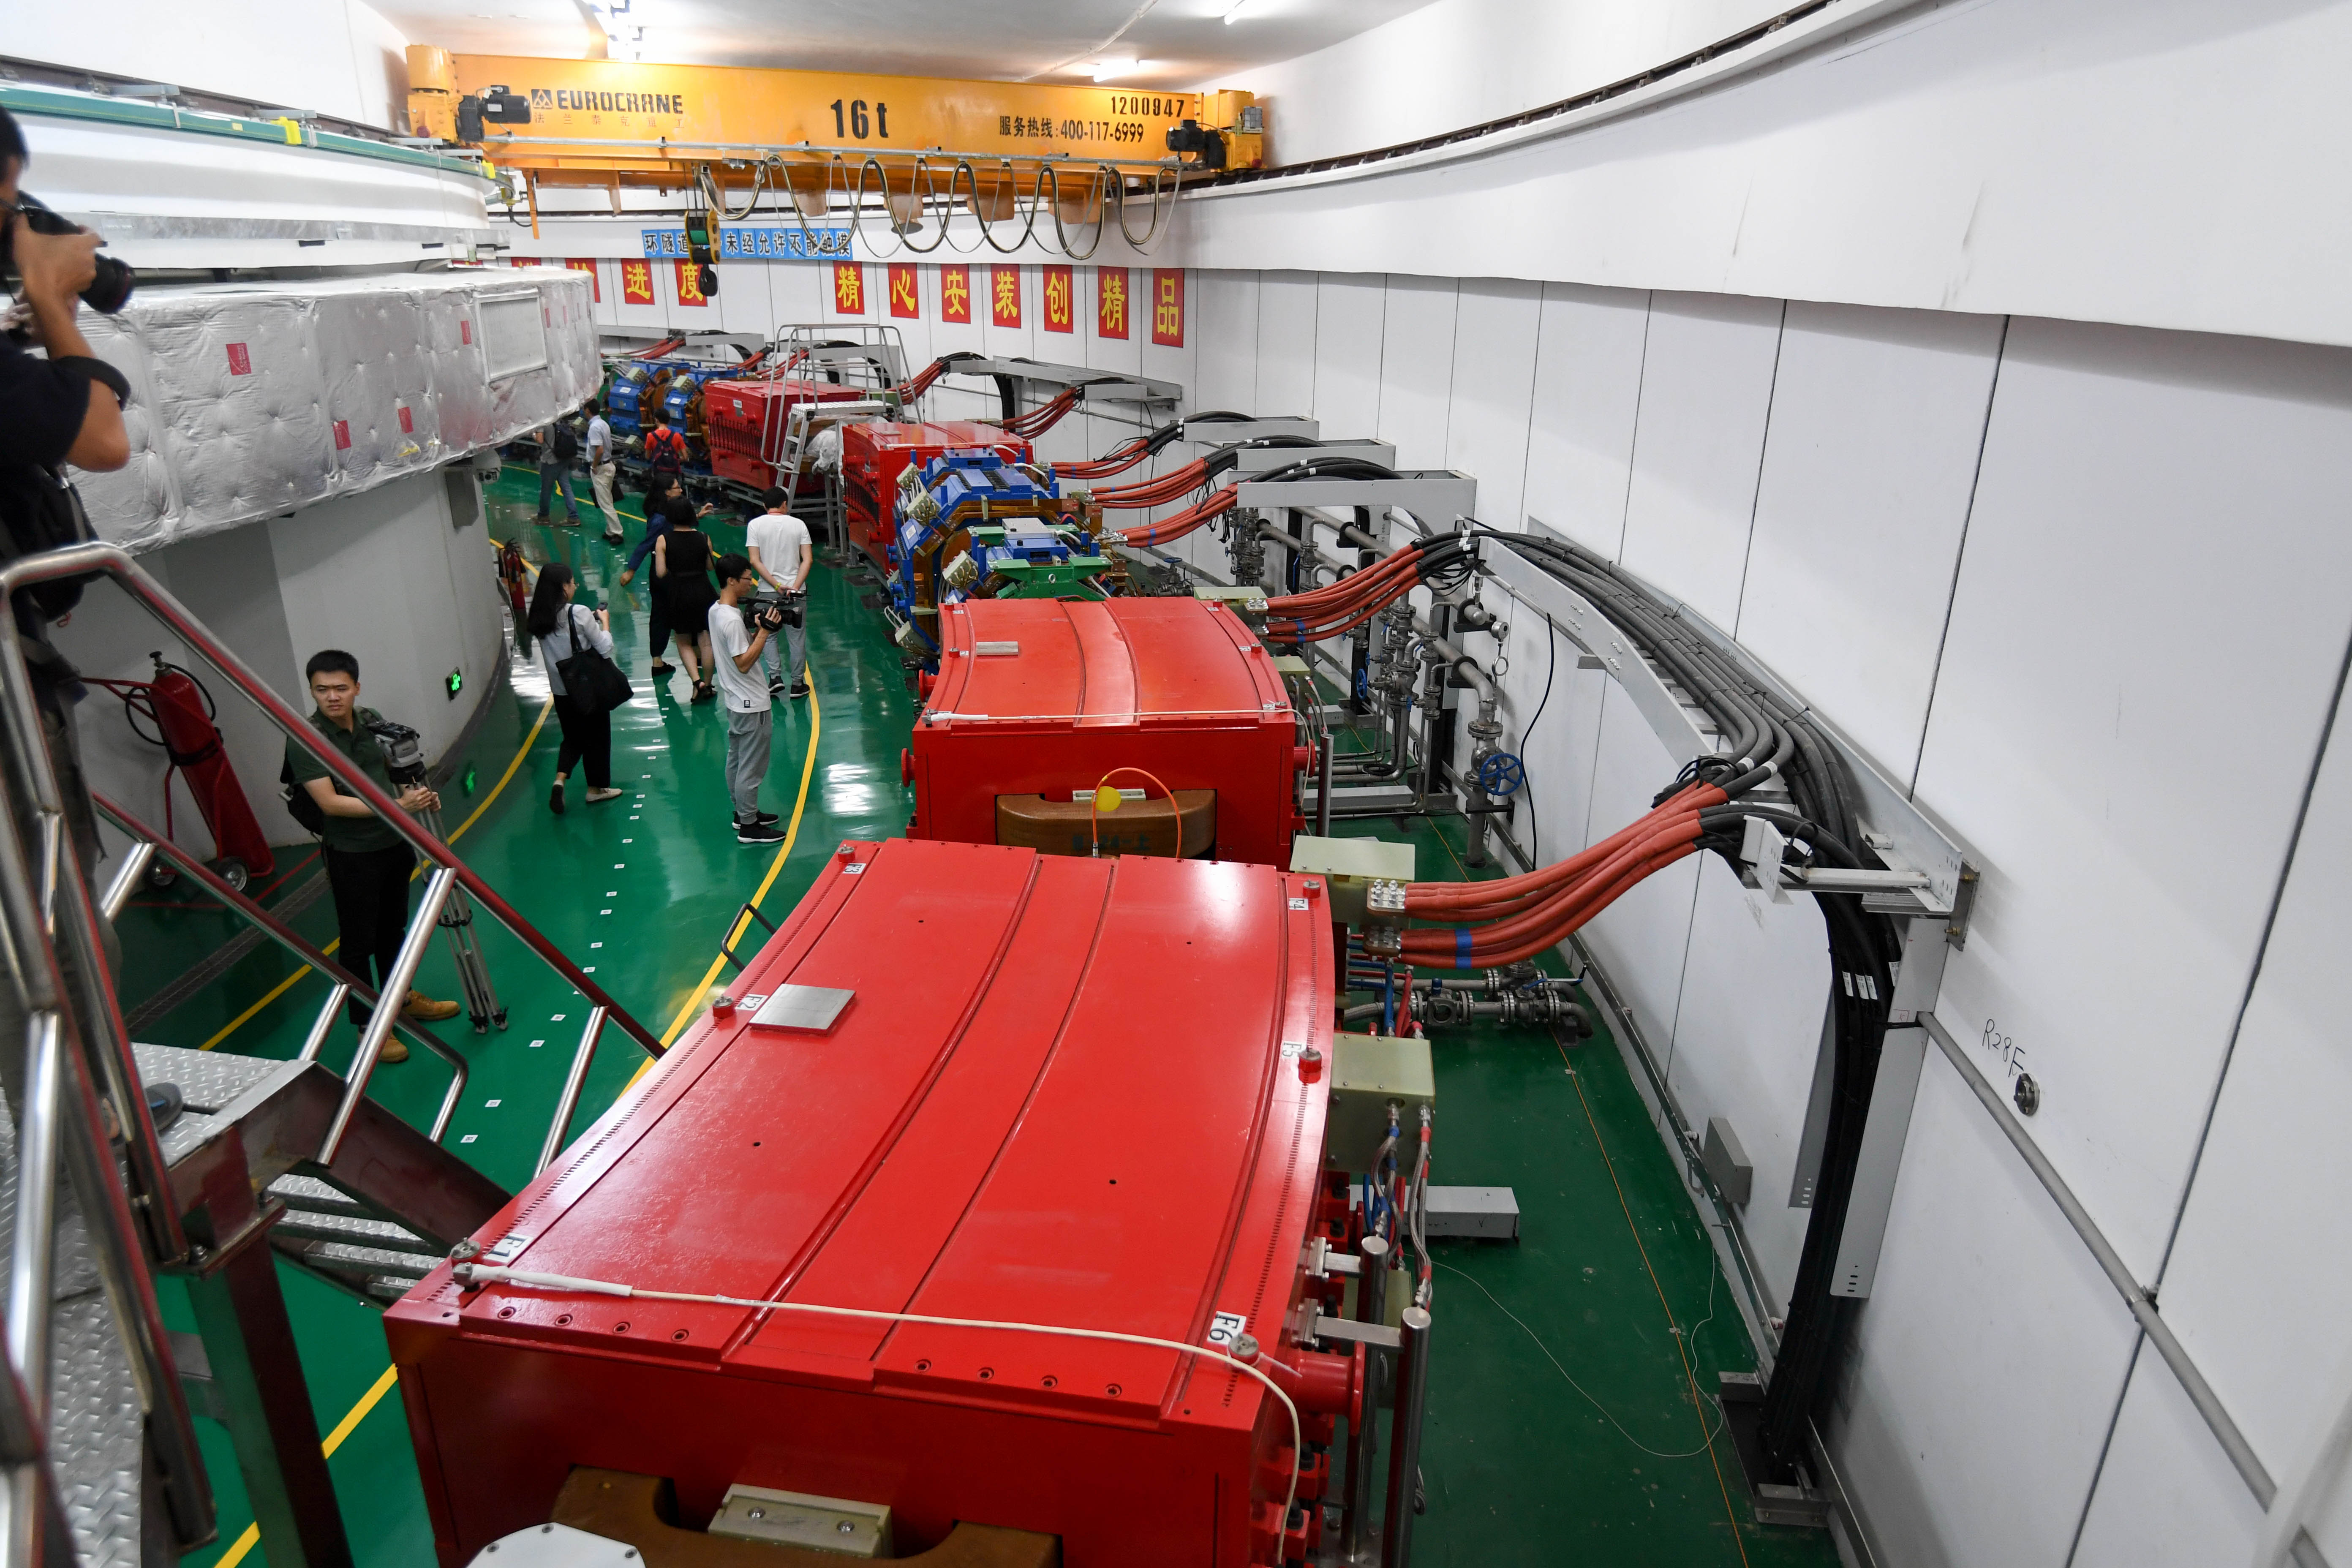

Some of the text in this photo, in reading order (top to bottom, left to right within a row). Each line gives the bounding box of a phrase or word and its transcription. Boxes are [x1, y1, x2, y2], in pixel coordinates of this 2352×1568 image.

[557, 90, 683, 114] EUROCRANE
[1111, 96, 1184, 117] 1200947
[844, 864, 863, 873] F3
[1289, 899, 1305, 909] F4
[738, 995, 764, 1009] F2
[1282, 1042, 1302, 1057] F5
[1982, 1019, 2025, 1078] R28F
[486, 1234, 528, 1258] F1
[1209, 1313, 1240, 1341] F6
